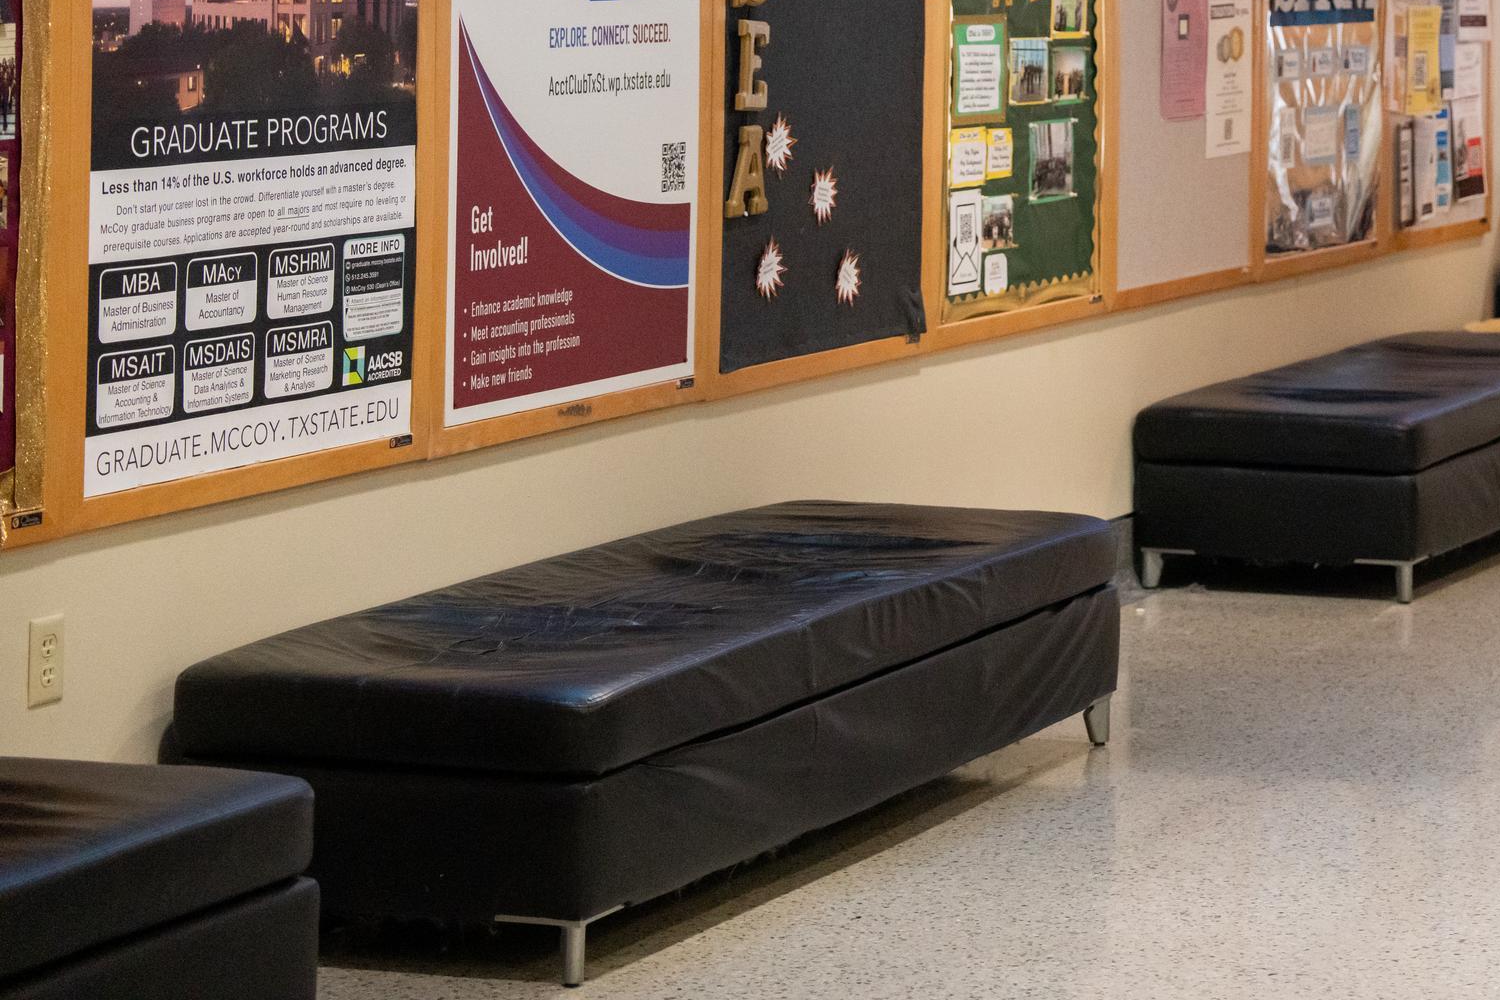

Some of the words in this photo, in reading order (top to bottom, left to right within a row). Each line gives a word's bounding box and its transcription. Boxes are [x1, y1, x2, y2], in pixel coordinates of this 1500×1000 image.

[550, 27, 589, 48] EXPLORE.
[592, 25, 630, 46] CONNECT.
[633, 23, 671, 44] SUCCEED.
[549, 69, 671, 96] AcctClubTxSt.wp.txstate.edu
[131, 119, 258, 158] GRADUATE
[267, 111, 387, 146] PROGRAMS
[102, 181, 130, 195] Less
[133, 179, 158, 192] than
[162, 175, 180, 190] 14%
[183, 174, 191, 188] of
[193, 173, 209, 187] the
[213, 171, 234, 184] U.S.
[238, 167, 287, 182] workforce
[290, 165, 315, 178] holds
[318, 165, 328, 175] an
[330, 159, 373, 174] advanced
[376, 158, 406, 172] degree.
[116, 204, 138, 216] Don't
[140, 202, 157, 214] start
[158, 203, 174, 214] your
[175, 200, 193, 210] career
[195, 196, 209, 208] lost
[211, 196, 217, 206] in
[220, 195, 231, 205] the
[259, 189, 299, 201] Differentiate
[100, 222, 128, 235] McCoy
[131, 218, 165, 232] graduate
[168, 216, 194, 228] business
[197, 212, 231, 226] programs
[471, 205, 493, 234] Get
[350, 243, 378, 255] MORE
[381, 239, 400, 251] INFO
[470, 236, 528, 271] Involved!
[275, 250, 330, 275] MSHRM
[122, 272, 160, 295] MBA
[277, 278, 299, 289] Master
[300, 276, 306, 286] of
[307, 274, 328, 286] Science
[206, 291, 231, 304] Master
[233, 289, 239, 301] of
[277, 291, 300, 301] Human
[302, 288, 327, 299] Resource
[471, 301, 500, 317] Enhance
[502, 293, 536, 313] academic
[537, 288, 573, 306] knowledge
[103, 305, 131, 318] Master
[133, 303, 140, 314] of
[142, 299, 174, 313] Business
[199, 306, 245, 320] Accountancy
[283, 301, 322, 314] Management
[111, 316, 166, 332] Administration
[471, 326, 489, 341] Meet
[490, 320, 528, 340] accounting
[530, 311, 575, 332] professionals
[273, 333, 328, 353] MSMRA
[471, 350, 487, 366] Gain
[488, 344, 516, 364] insights
[518, 339, 531, 356] into
[533, 337, 544, 353] the
[545, 333, 581, 354] profession
[189, 339, 250, 367] MSDAIS
[273, 356, 295, 368] Master
[297, 355, 303, 366] of
[304, 353, 325, 364] Science
[368, 351, 403, 370] AACSB
[112, 352, 166, 379] MSAIT
[191, 369, 214, 382] Master
[215, 368, 222, 378] of
[223, 366, 248, 378] Science
[270, 369, 300, 383] Marketing
[301, 365, 328, 378] Research
[367, 368, 402, 382] ACCREDITED
[108, 383, 131, 396] Master
[133, 381, 140, 392] of
[141, 379, 166, 392] Science
[193, 382, 209, 395] Data
[210, 379, 238, 393] Analytics
[239, 378, 245, 388] &
[284, 383, 291, 392] &
[292, 380, 315, 391] Analysis
[470, 375, 490, 390] Make
[491, 372, 506, 386] new
[508, 367, 533, 383] friends
[115, 395, 149, 409] Accounting
[151, 392, 158, 403] &
[187, 395, 222, 409] Information
[224, 391, 250, 405] Systems
[98, 410, 136, 424] Information
[137, 405, 171, 420] Technology
[96, 397, 400, 476] GRADUATE.MCCOY.TXSTATE.EDU
